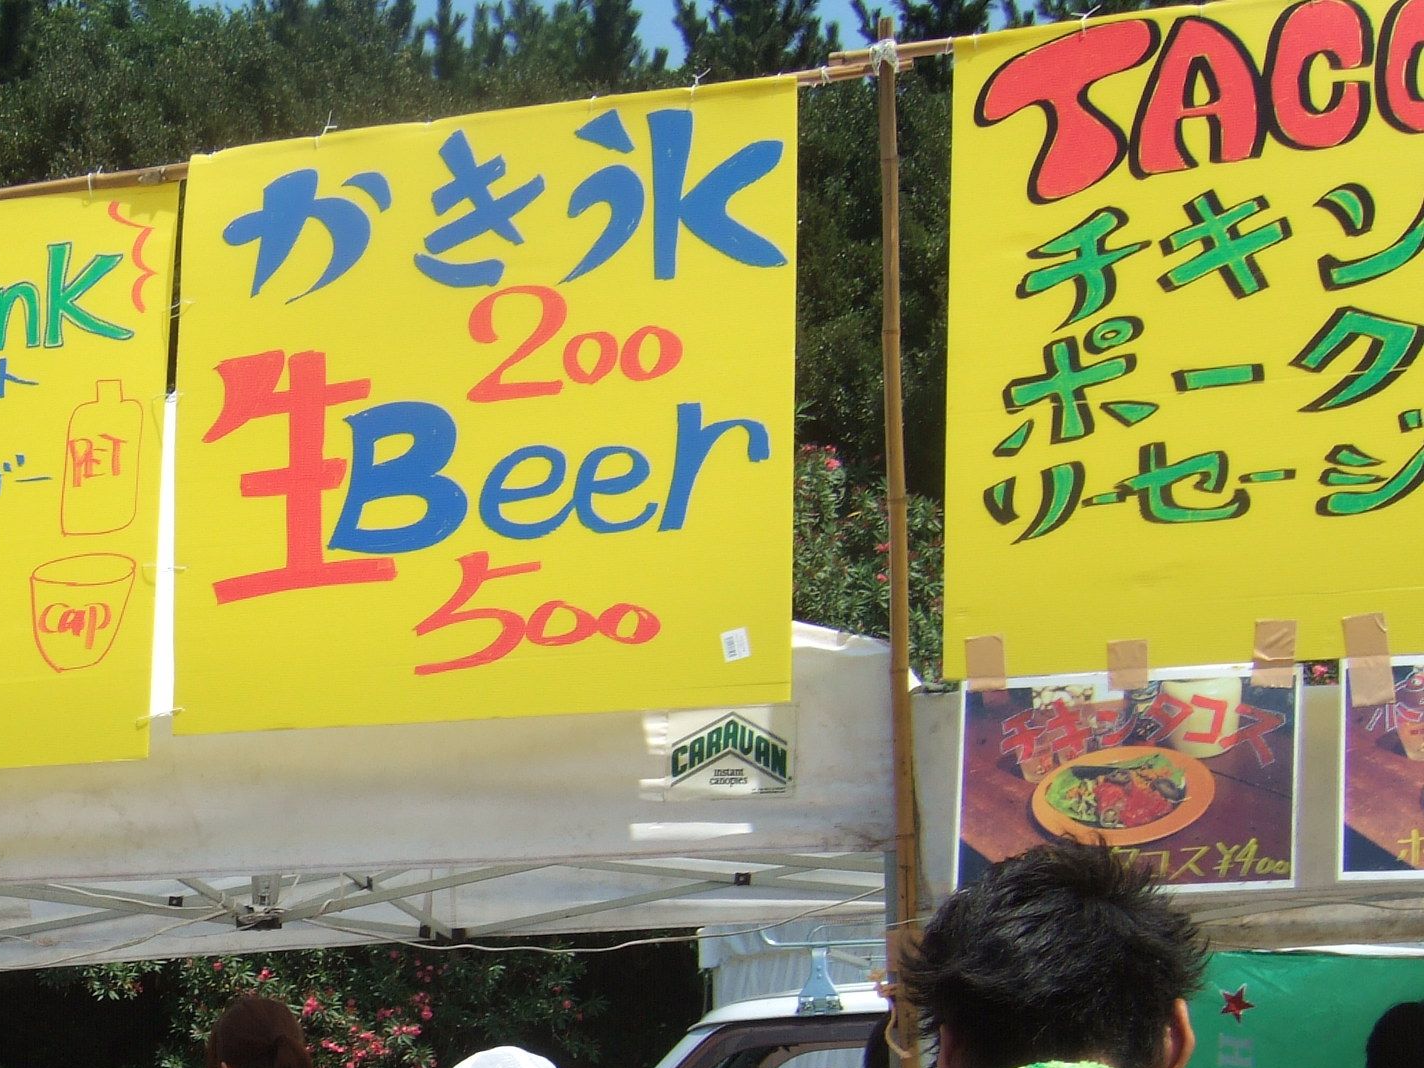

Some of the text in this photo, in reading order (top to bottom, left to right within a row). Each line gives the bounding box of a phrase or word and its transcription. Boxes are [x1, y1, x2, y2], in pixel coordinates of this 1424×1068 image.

[466, 284, 684, 403] 200
[68, 433, 129, 488] PET
[326, 399, 770, 554] Beer
[414, 550, 662, 675] 500
[671, 718, 788, 778] CARAVAN
[713, 768, 745, 778] instant
